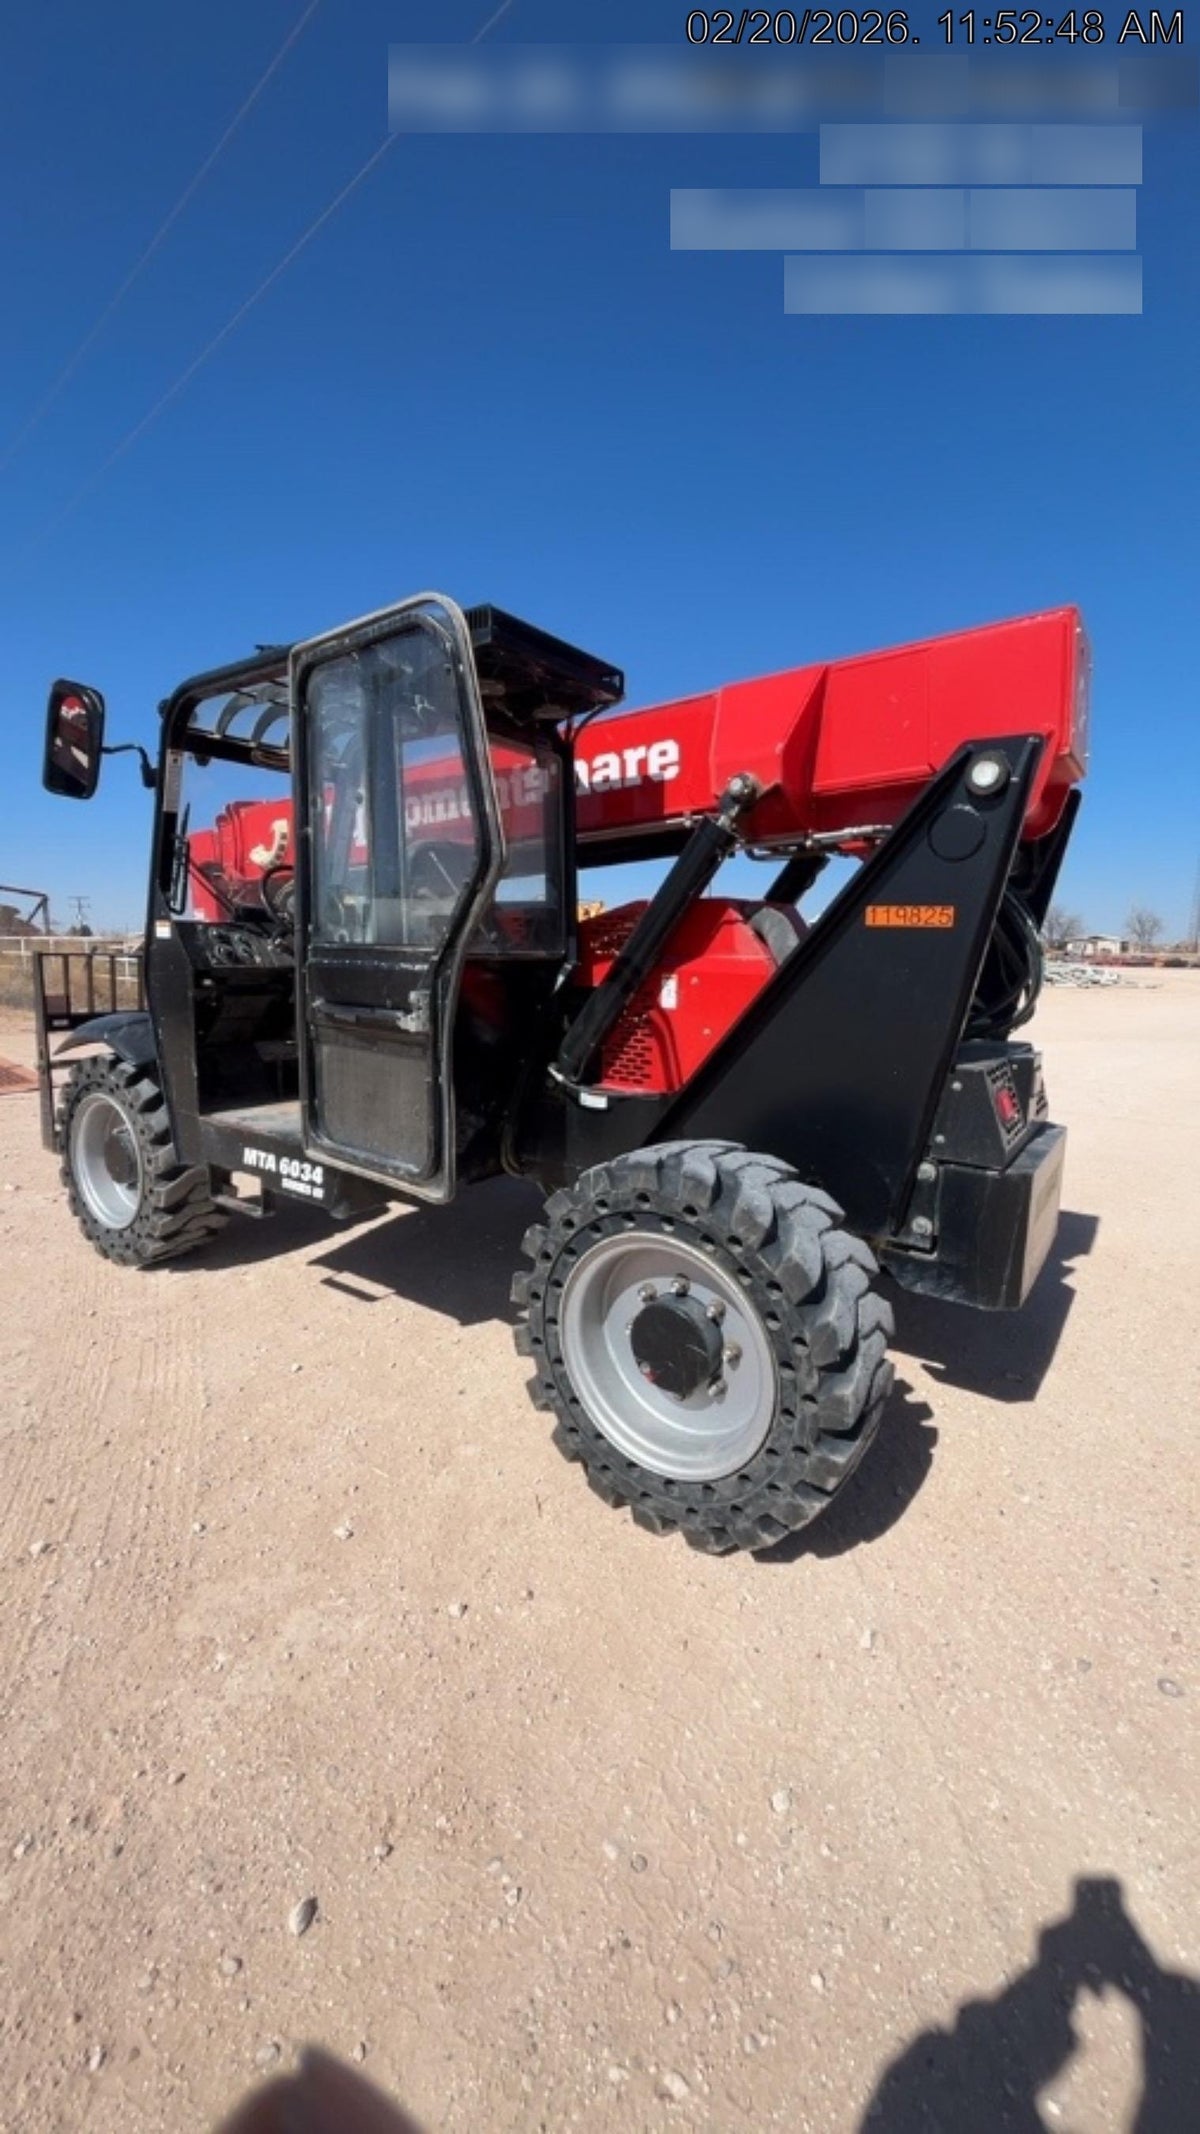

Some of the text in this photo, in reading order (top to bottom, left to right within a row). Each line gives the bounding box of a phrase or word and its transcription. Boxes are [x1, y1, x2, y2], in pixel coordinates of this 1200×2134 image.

[870, 907, 952, 925] 119825
[243, 1147, 323, 1185] MTA 6034
